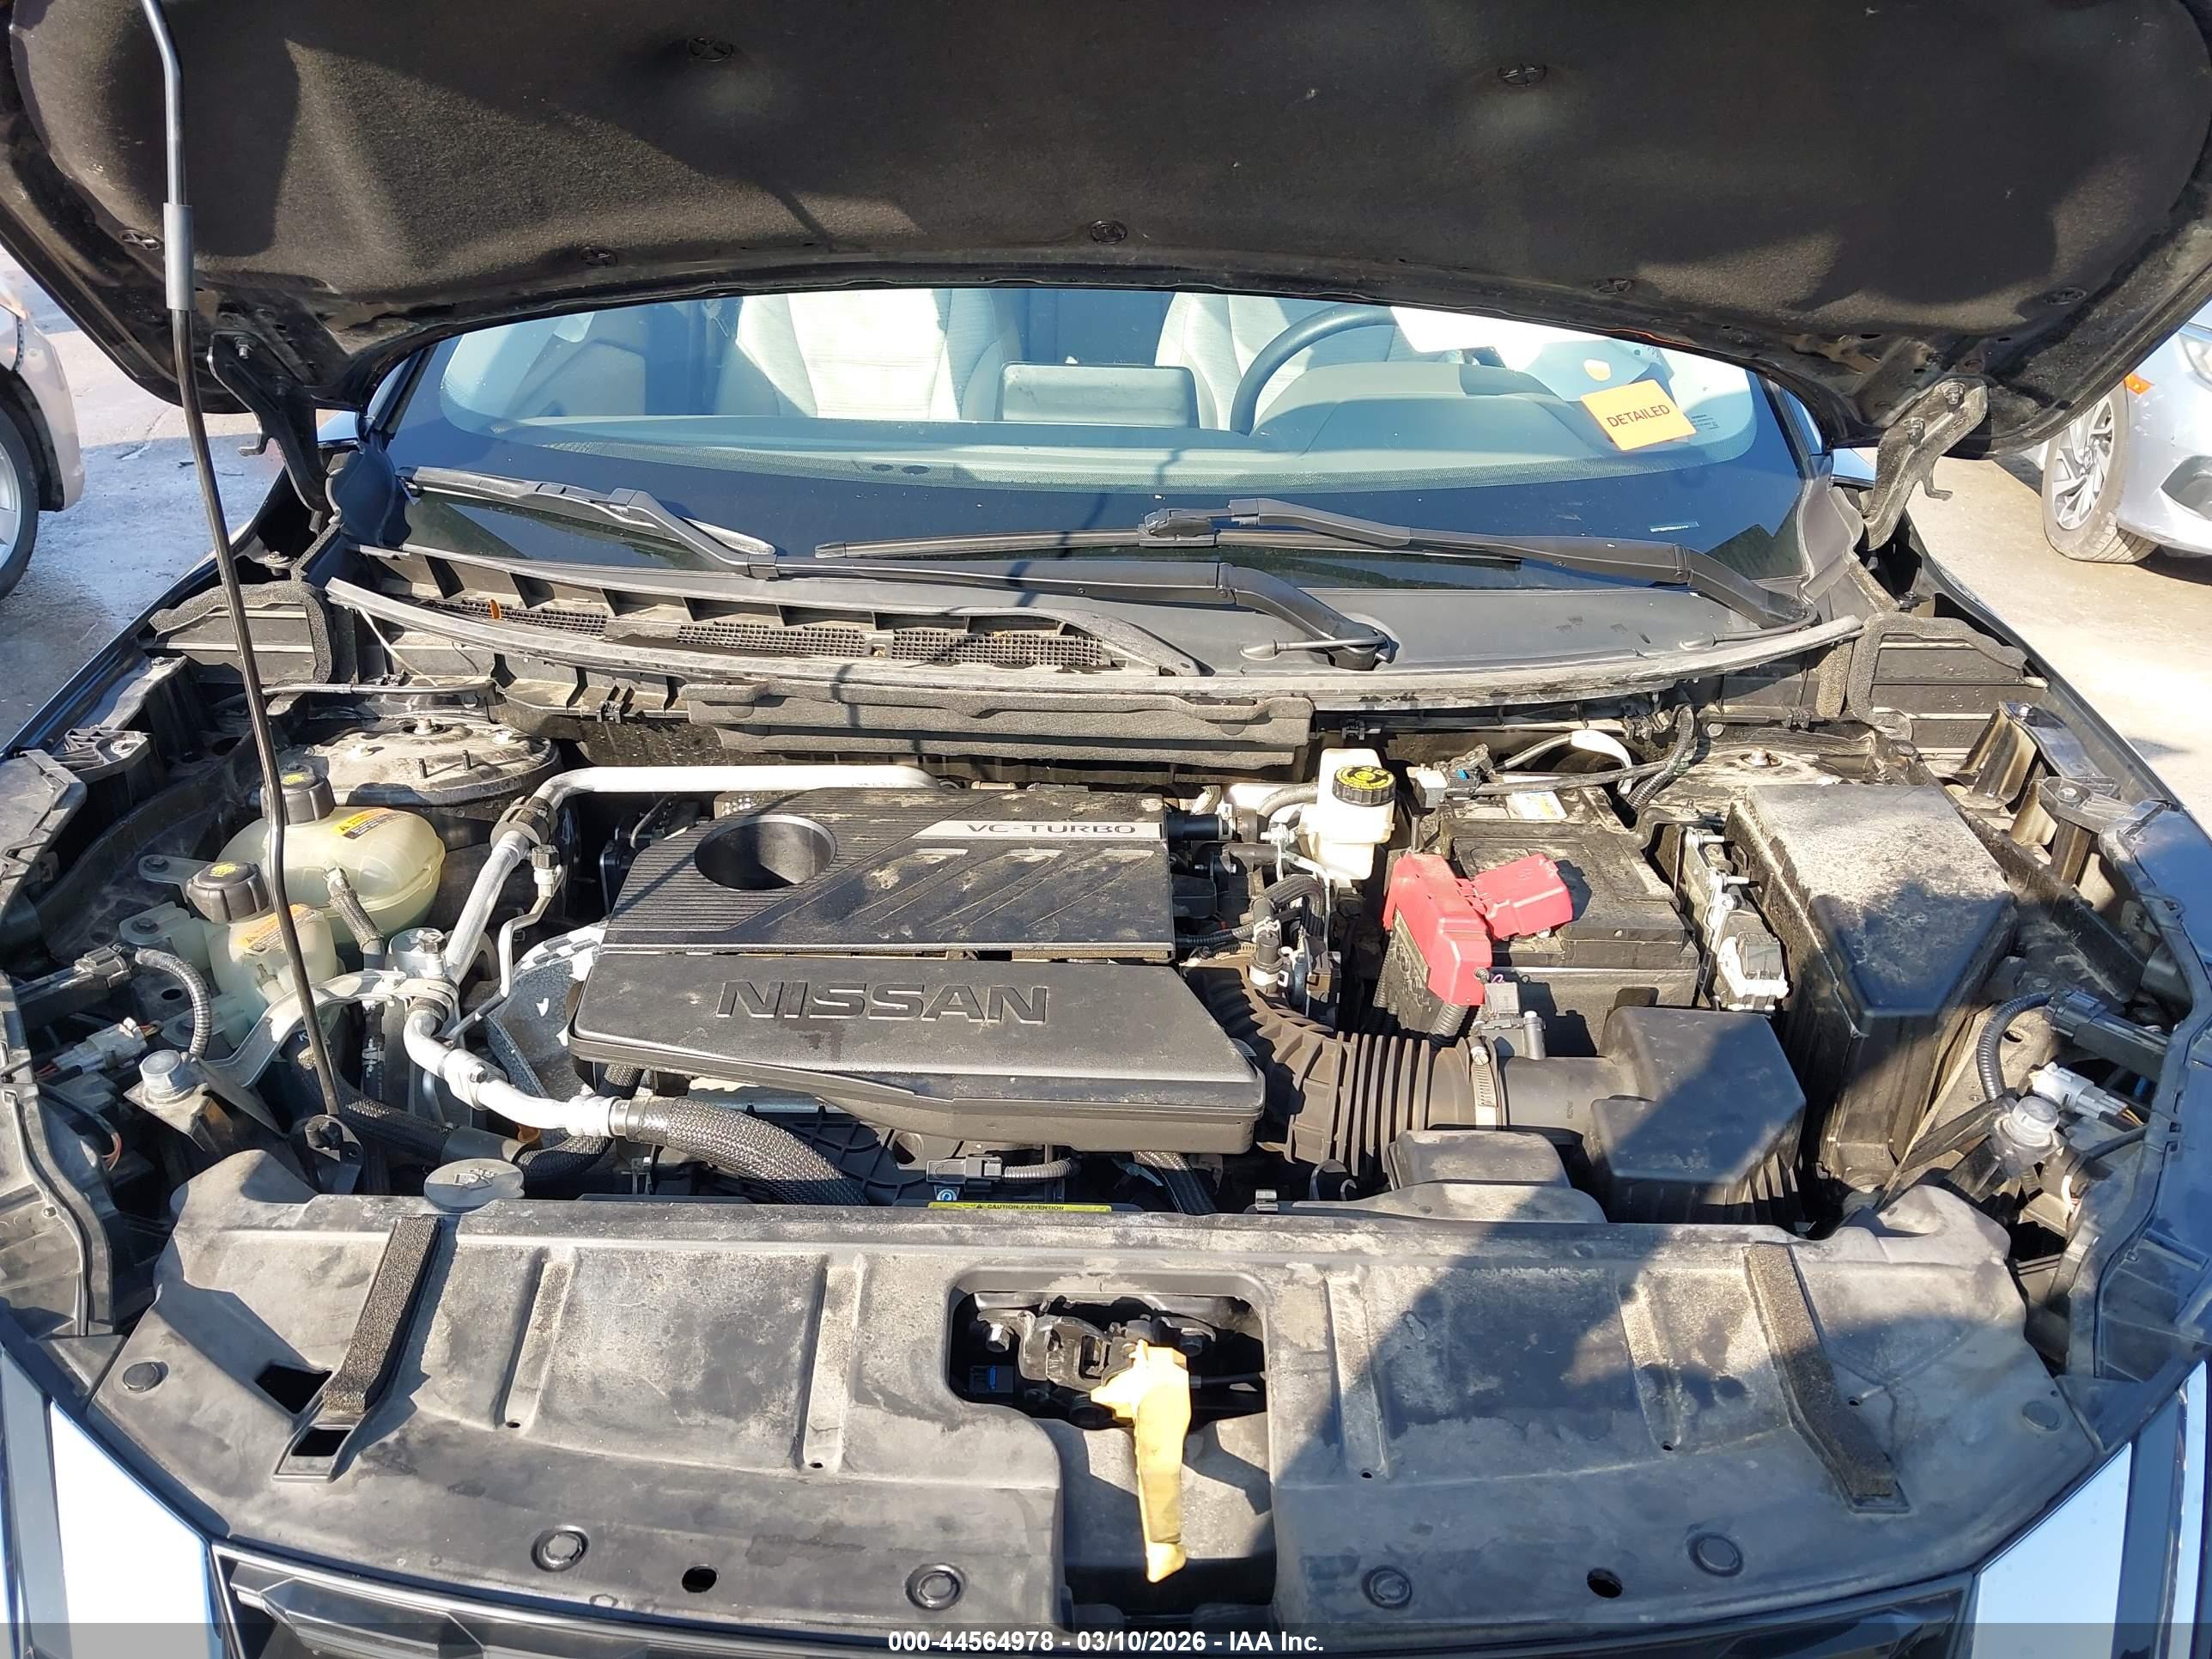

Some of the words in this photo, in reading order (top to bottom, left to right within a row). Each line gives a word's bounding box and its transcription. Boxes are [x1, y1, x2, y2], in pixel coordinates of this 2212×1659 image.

[1607, 404, 1670, 428] DETAILED
[966, 823, 1136, 834] VC-TURBO
[715, 981, 1048, 1024] NISSAN
